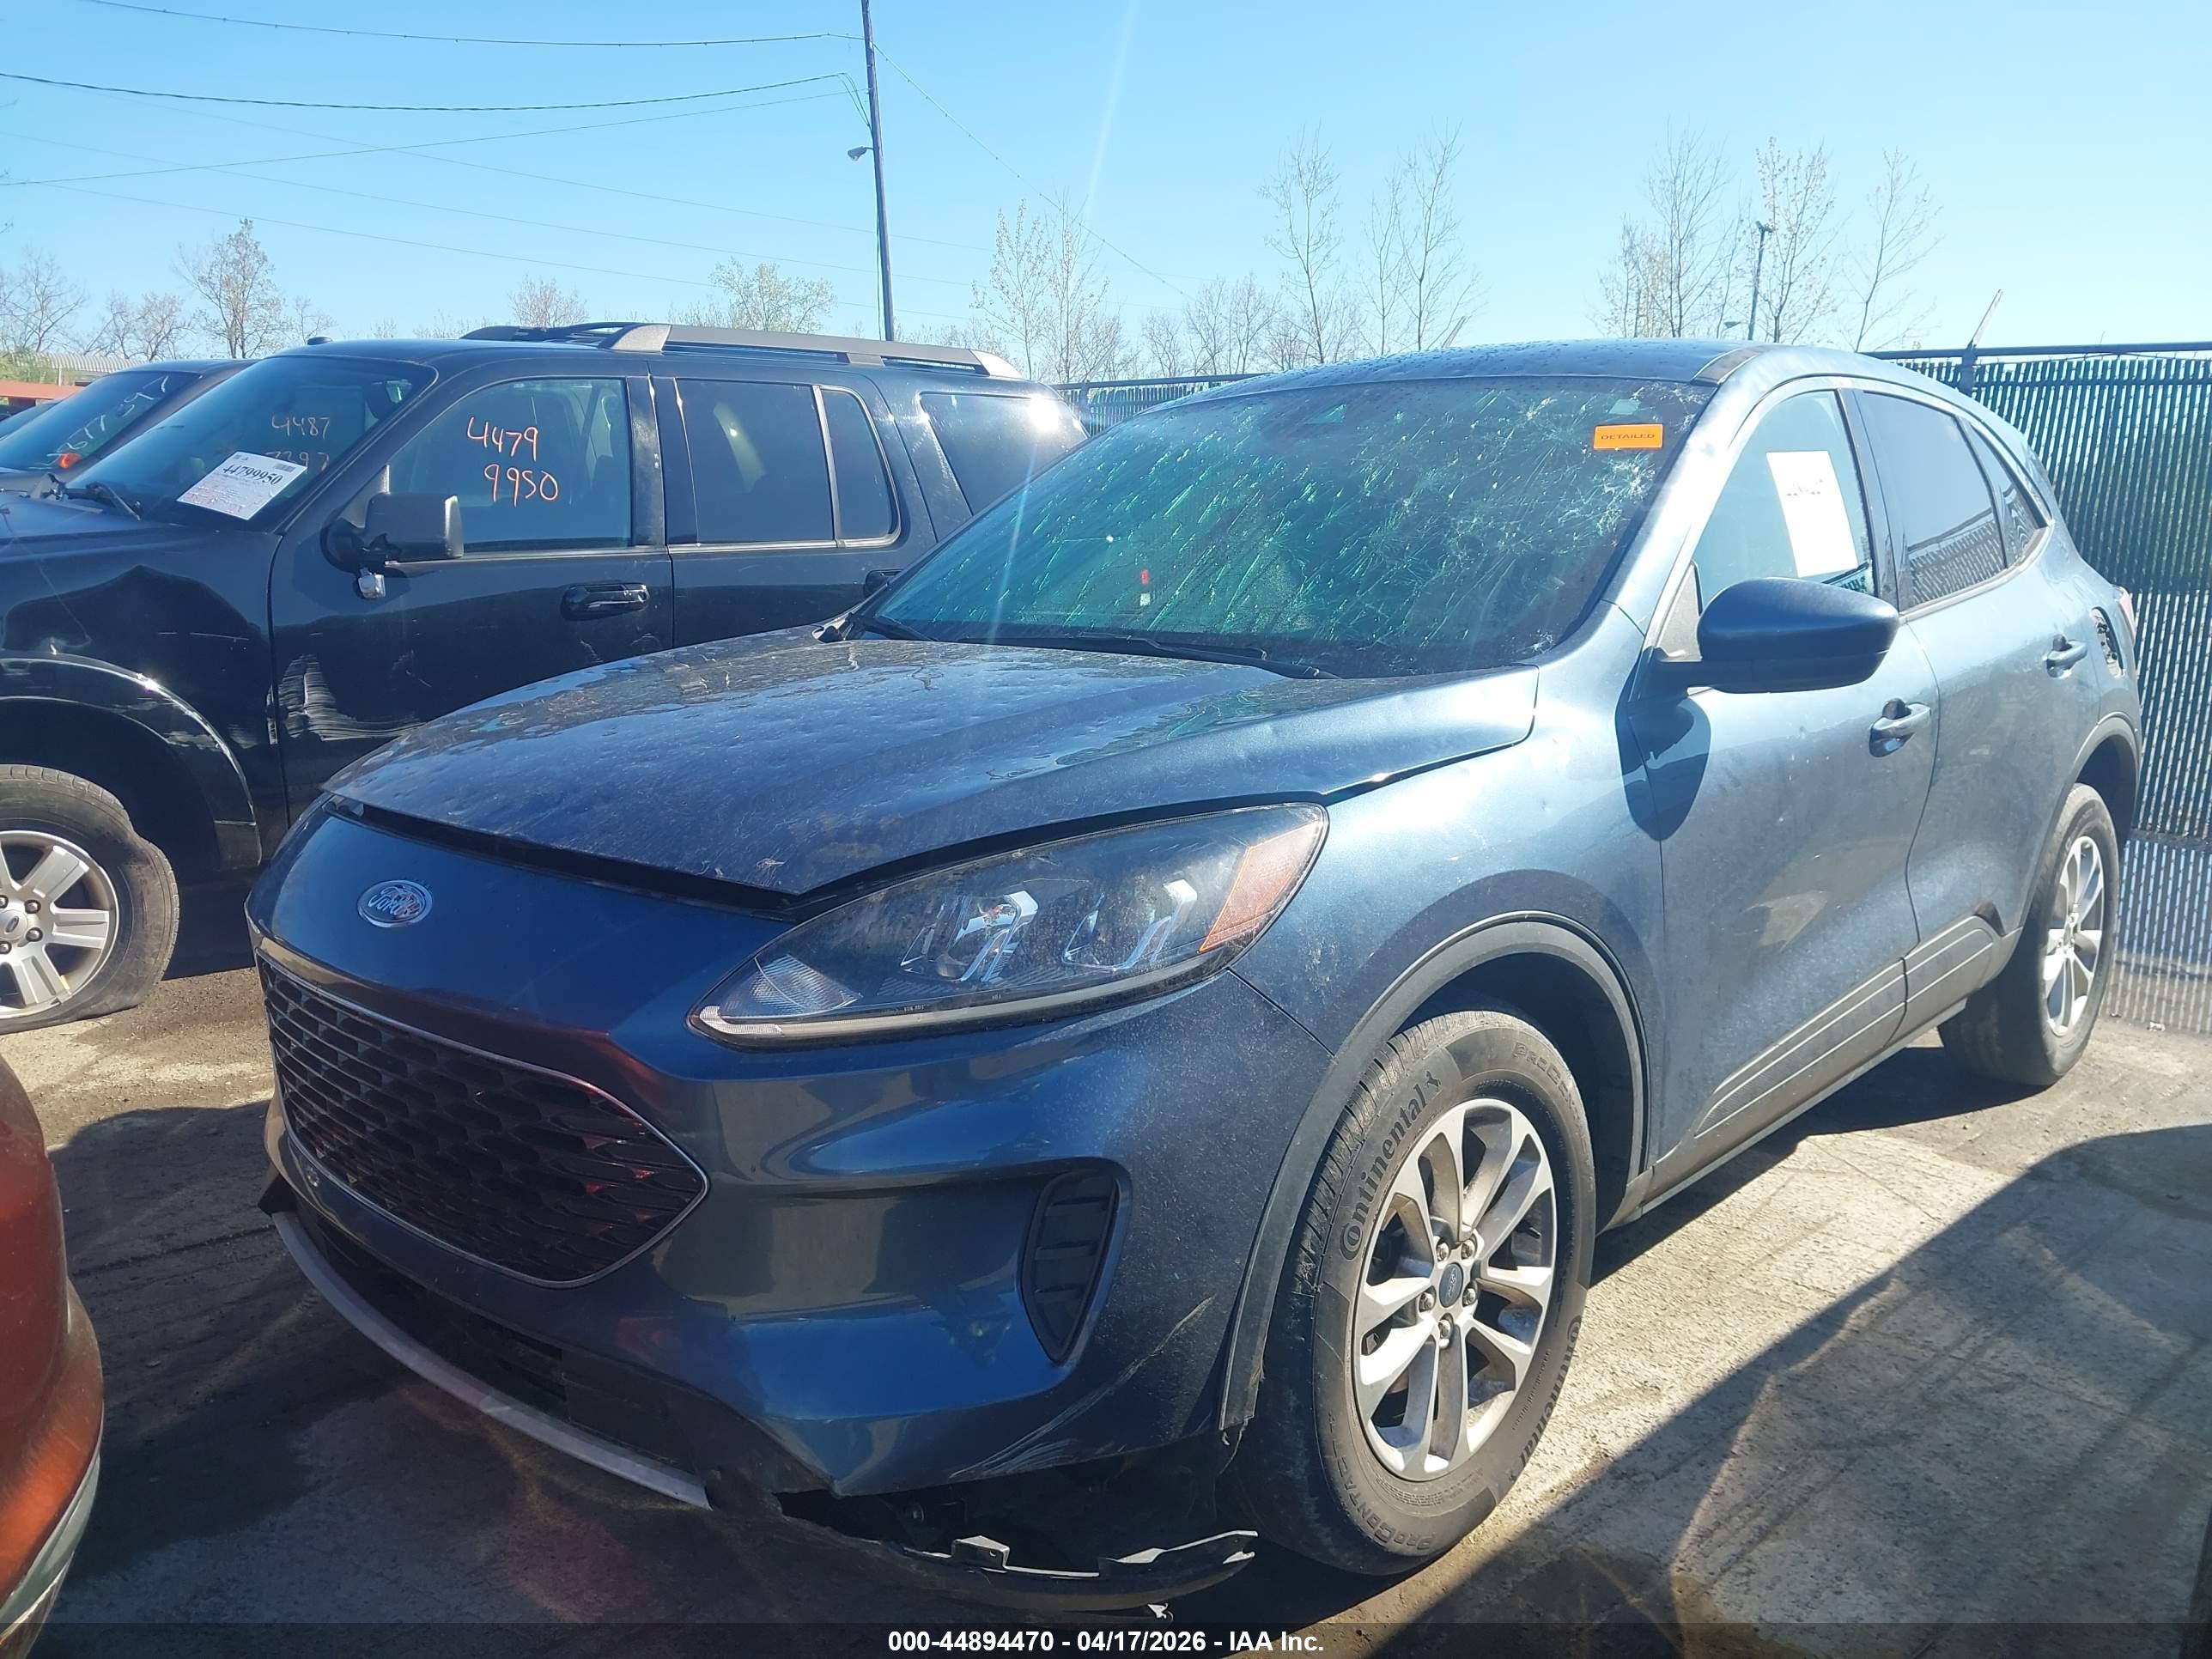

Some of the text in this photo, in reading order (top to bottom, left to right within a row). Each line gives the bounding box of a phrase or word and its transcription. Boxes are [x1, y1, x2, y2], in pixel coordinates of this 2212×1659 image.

[271, 416, 330, 440] 4487
[467, 416, 538, 462] 4479
[223, 464, 283, 485] 44799950
[483, 464, 558, 507] 9950
[368, 886, 421, 915] Ford
[1340, 1083, 1427, 1261] Continental
